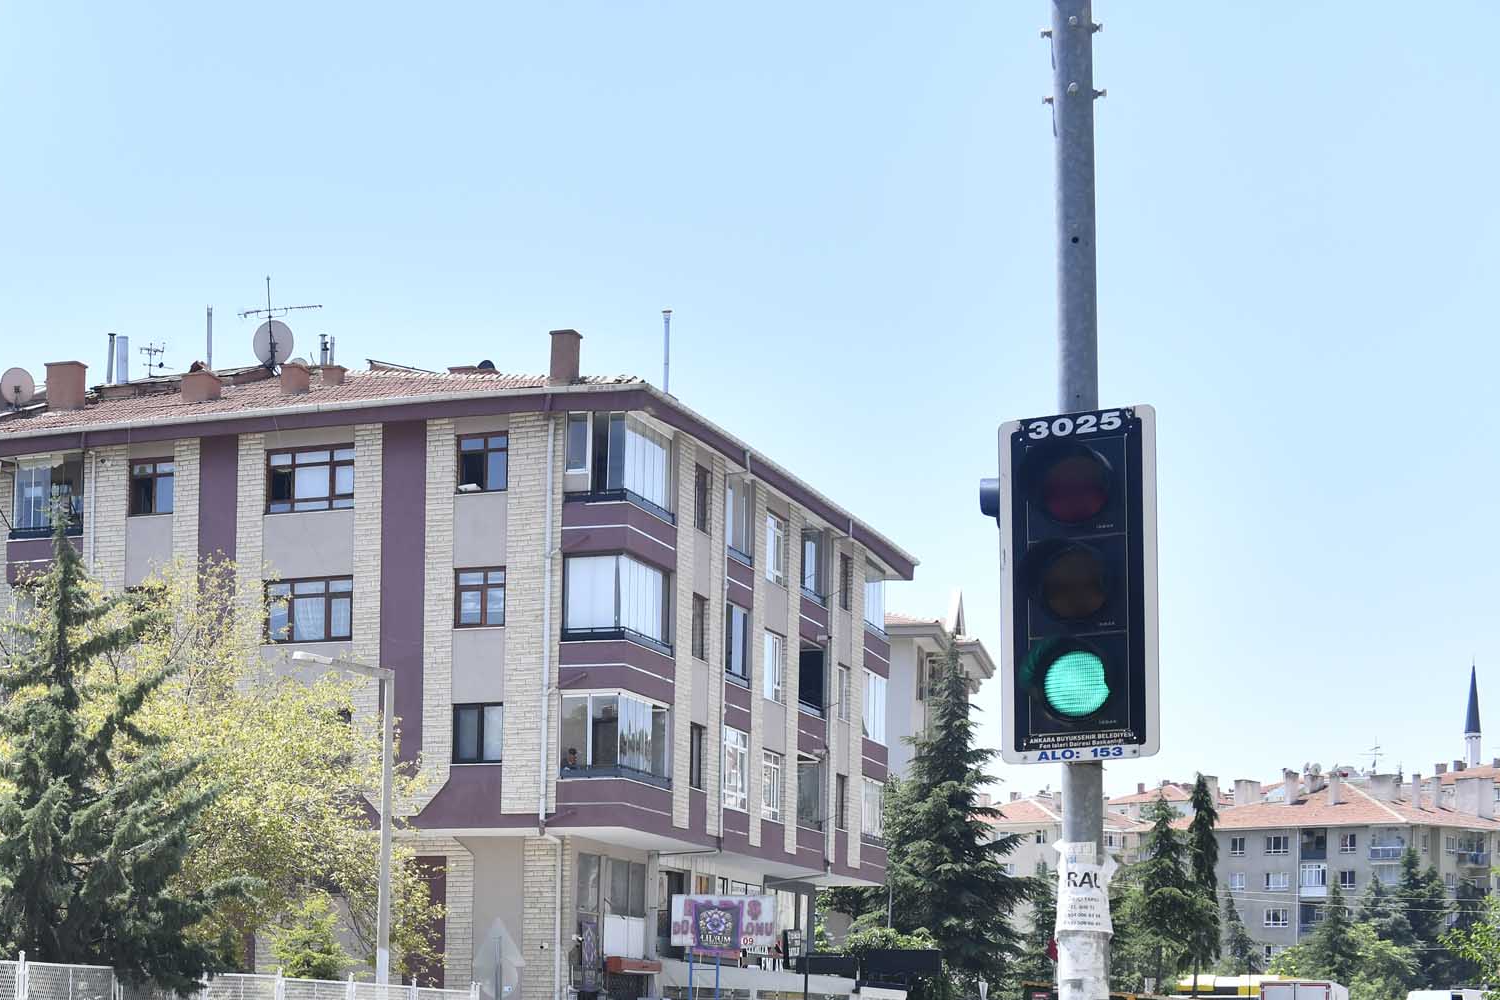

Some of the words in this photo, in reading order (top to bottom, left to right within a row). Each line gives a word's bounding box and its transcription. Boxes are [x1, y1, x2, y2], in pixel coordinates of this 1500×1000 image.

[1028, 410, 1122, 440] 3025
[1038, 748, 1080, 761] ALO:
[1091, 746, 1124, 758] 153
